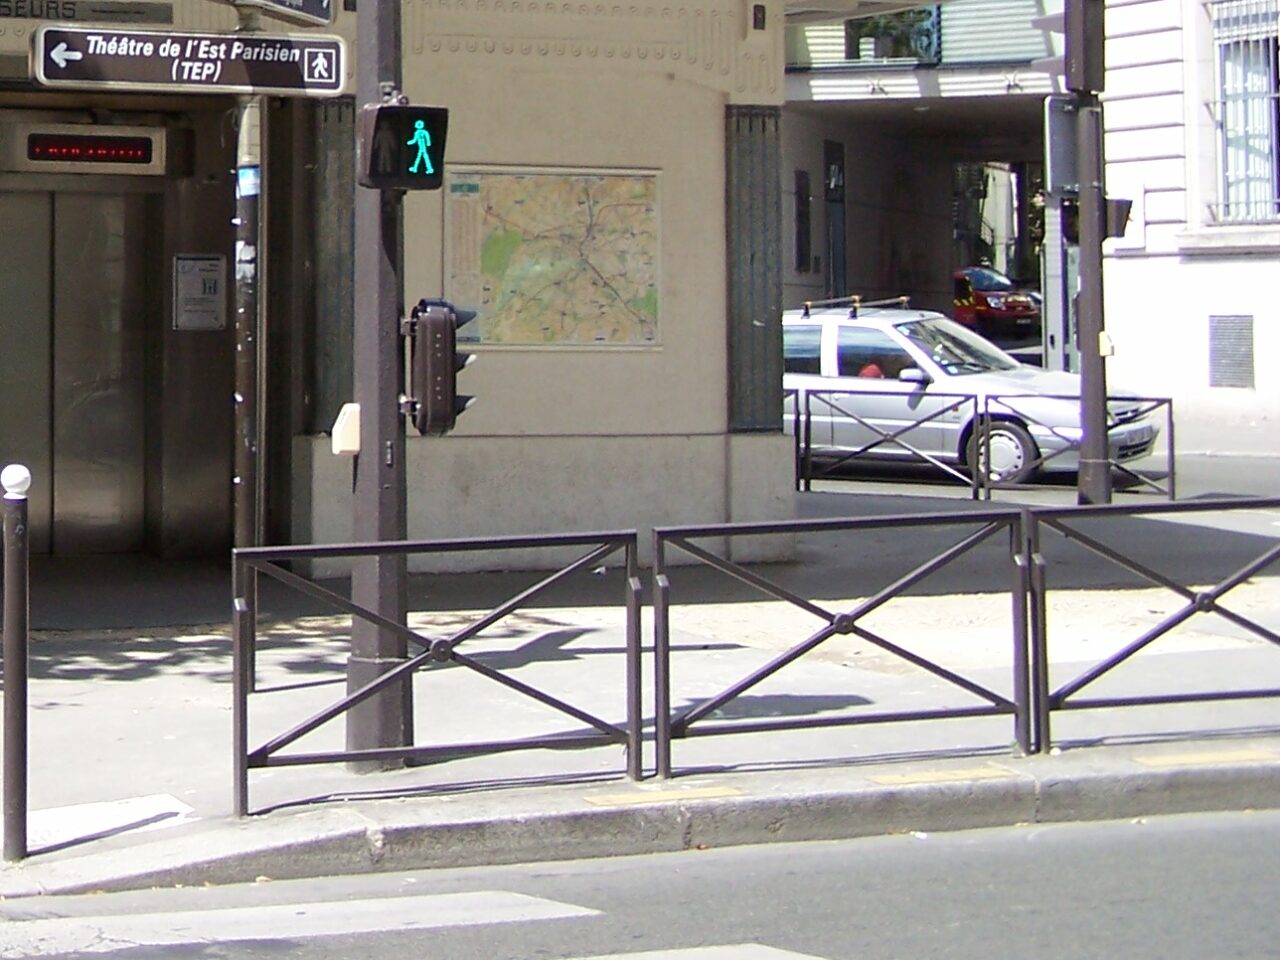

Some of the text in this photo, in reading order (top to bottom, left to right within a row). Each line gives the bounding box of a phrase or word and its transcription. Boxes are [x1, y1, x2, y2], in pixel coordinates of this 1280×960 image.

[86, 36, 154, 57] Théâtre
[159, 39, 181, 58] de
[230, 41, 300, 62] Parisien
[172, 59, 222, 83] (TEP)
